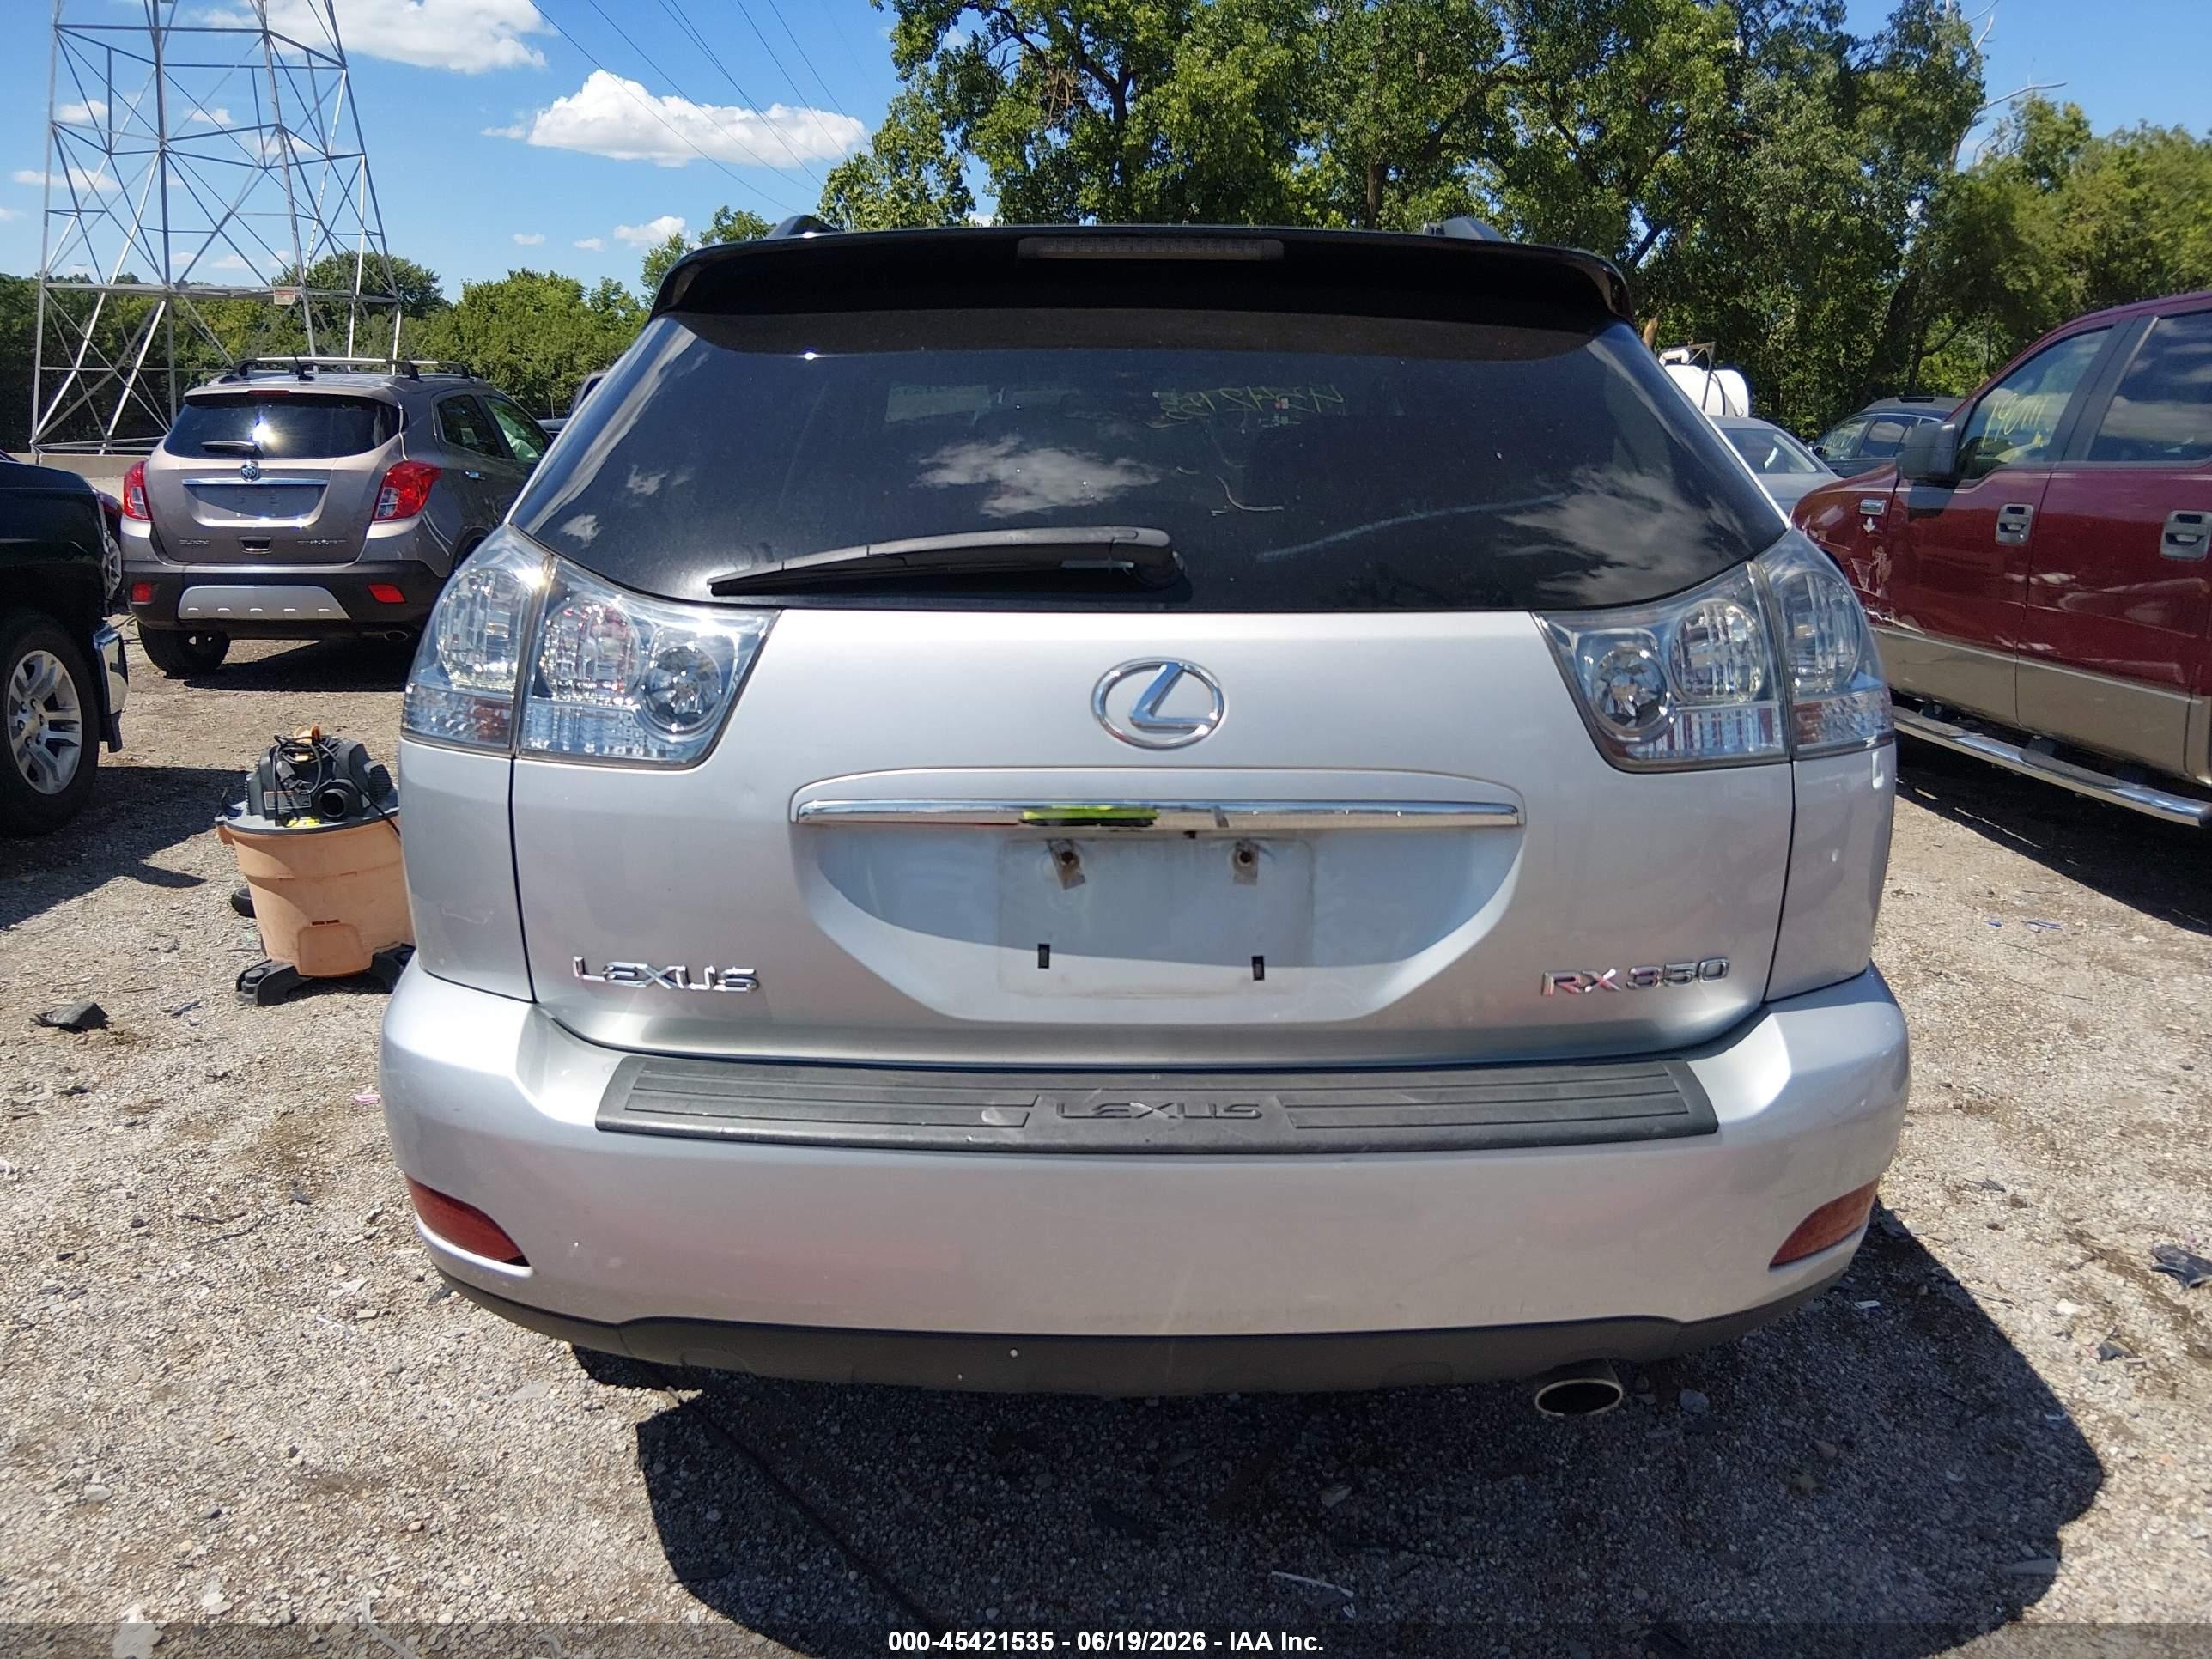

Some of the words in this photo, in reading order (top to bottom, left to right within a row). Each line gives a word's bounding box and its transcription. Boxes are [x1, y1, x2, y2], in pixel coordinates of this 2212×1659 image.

[572, 955, 759, 992] LEXUS
[1541, 968, 1621, 996] RX
[1626, 956, 1730, 992] 350
[1055, 1101, 1263, 1120] LEXUS
